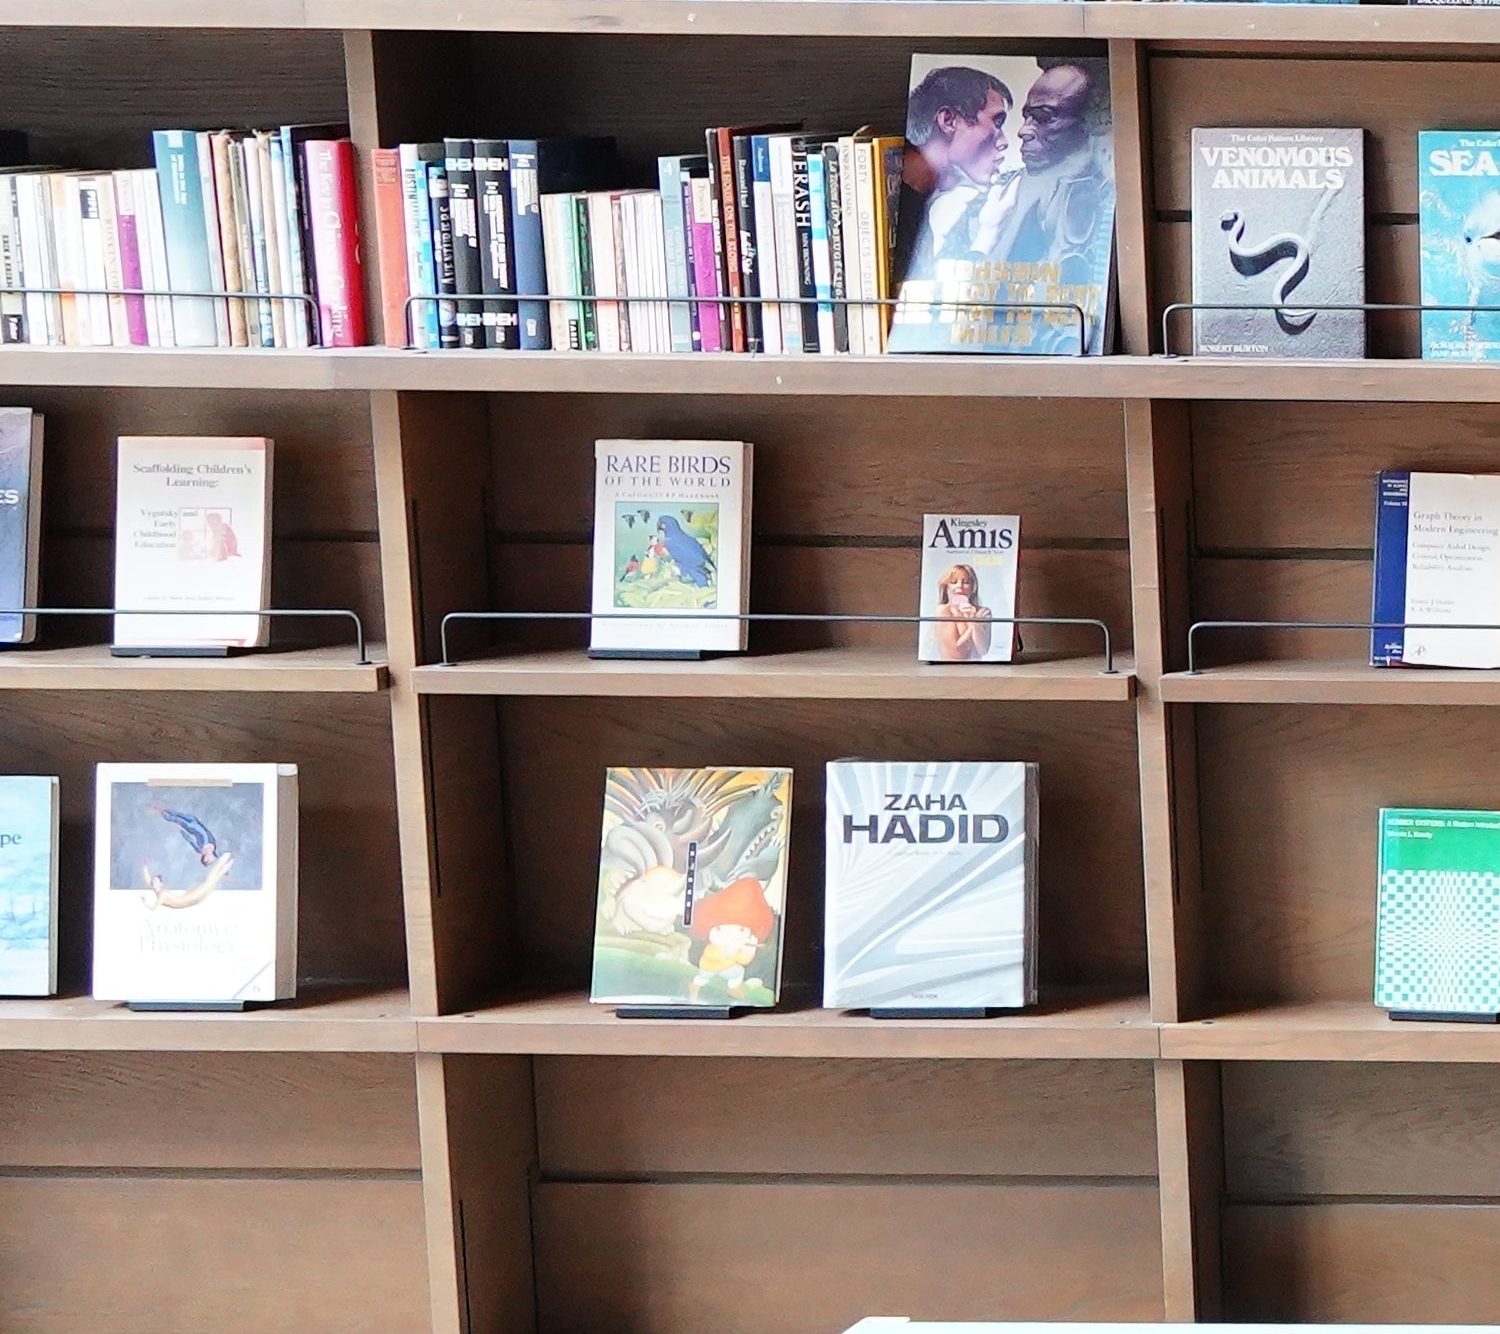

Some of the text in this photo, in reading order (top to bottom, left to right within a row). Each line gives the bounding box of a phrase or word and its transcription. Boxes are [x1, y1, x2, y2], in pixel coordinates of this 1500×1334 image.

[1200, 146, 1355, 168] VENOMOUS
[1212, 169, 1346, 188] ANIMALS
[605, 454, 731, 475] RARE BIRDS
[930, 519, 1013, 550] Amis
[884, 793, 968, 811] ZAHA
[843, 814, 1010, 844] HADID
